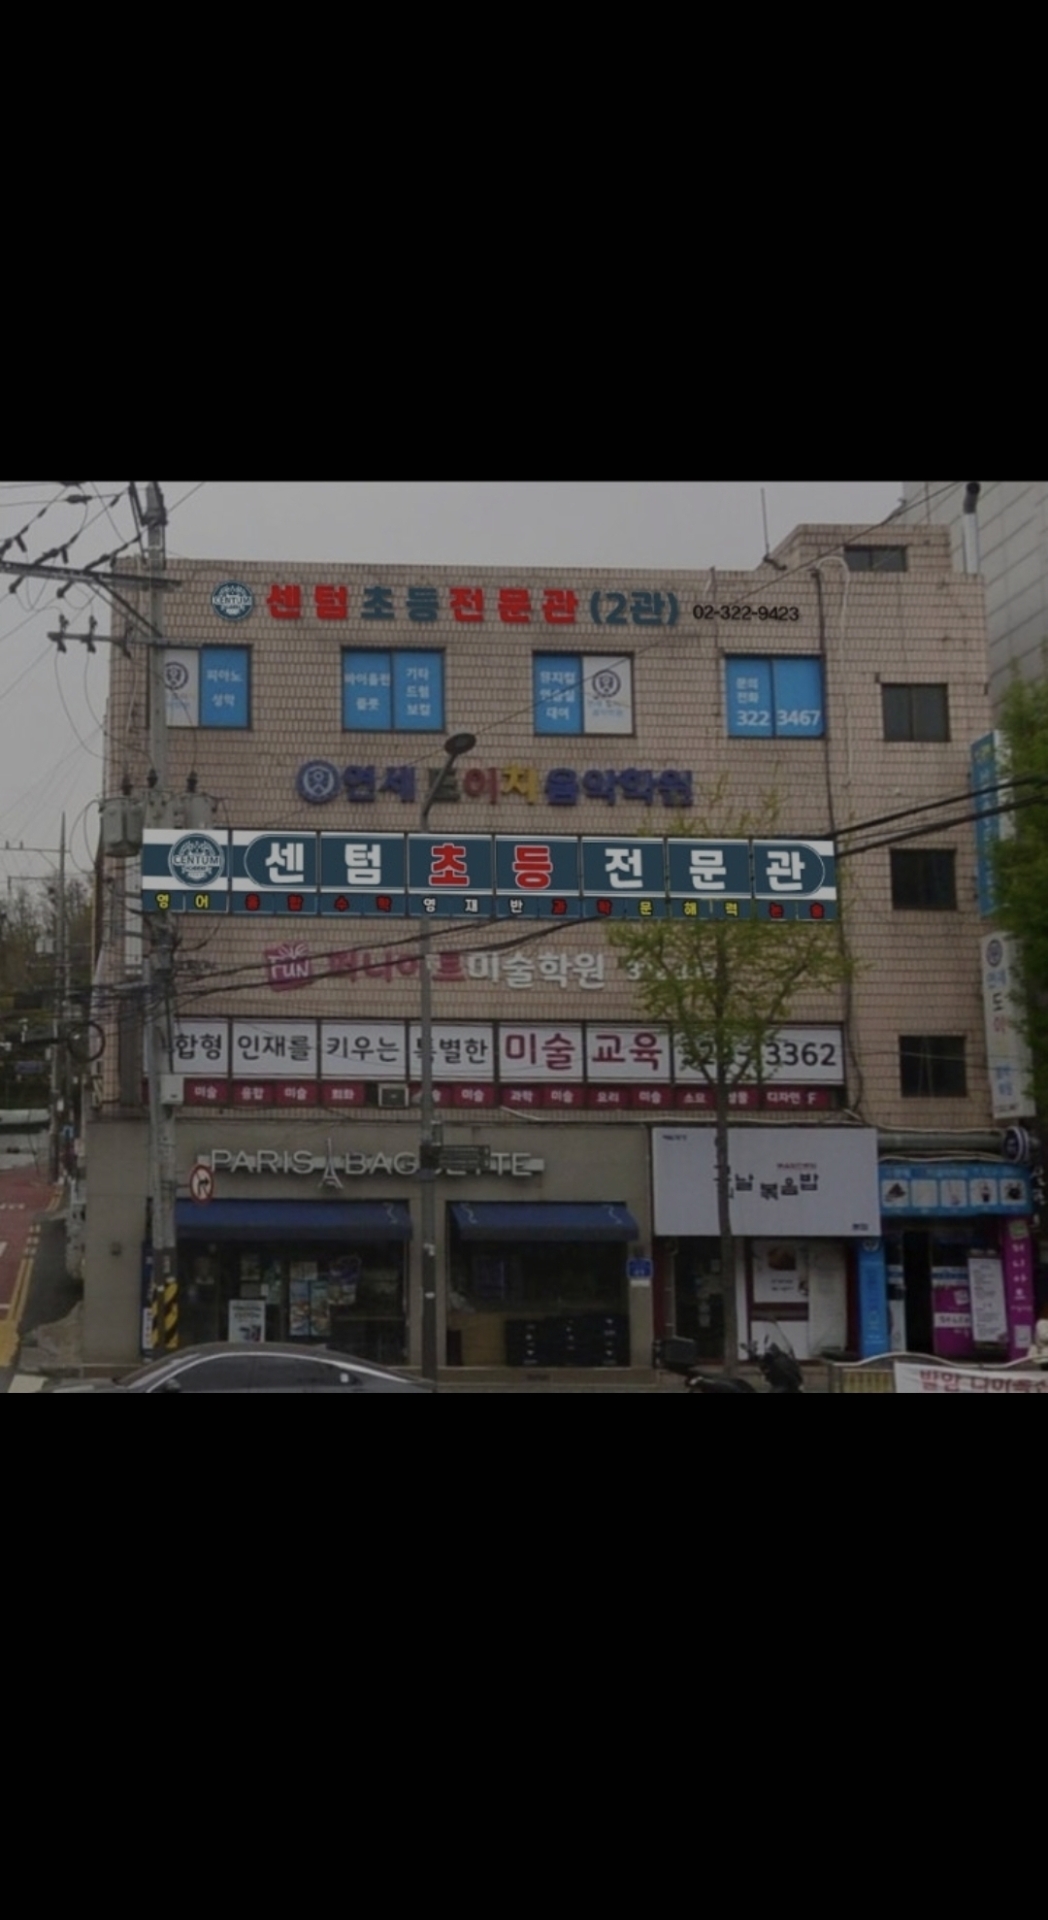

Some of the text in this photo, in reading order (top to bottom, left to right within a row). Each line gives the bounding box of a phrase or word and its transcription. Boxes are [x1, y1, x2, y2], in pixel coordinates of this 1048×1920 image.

[590, 589, 680, 626] (2관)
[692, 604, 800, 622] 02-322-9423
[207, 669, 242, 682] 피아노
[406, 667, 430, 681] 기타
[737, 709, 821, 726] 322 3467
[172, 855, 220, 866] CENTUM
[237, 1034, 313, 1061] 인재를
[326, 1036, 400, 1063] 키우는
[504, 1033, 576, 1070] 미술
[591, 1032, 663, 1071] 교육
[194, 1085, 218, 1099] 미술
[284, 1087, 308, 1100] 미술
[461, 1089, 484, 1103] 미술
[551, 1090, 574, 1104] 미술
[639, 1091, 662, 1104] 미술
[766, 1091, 801, 1105] 디자인
[210, 1149, 315, 1175] PARIS
[760, 1173, 819, 1200] 볶음밥
